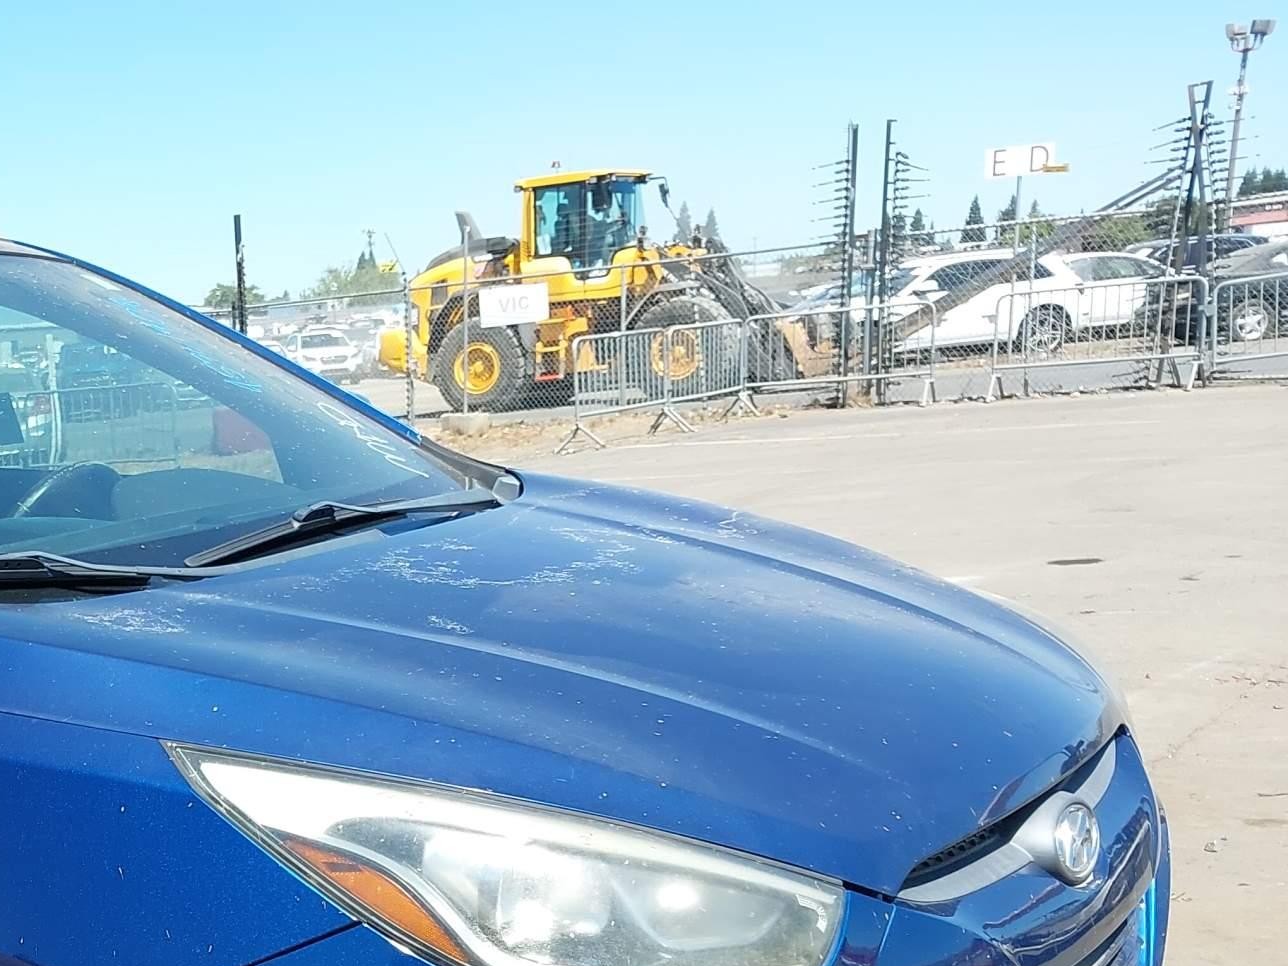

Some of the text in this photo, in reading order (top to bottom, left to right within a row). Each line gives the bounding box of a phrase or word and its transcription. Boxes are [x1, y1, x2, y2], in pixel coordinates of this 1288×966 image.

[992, 145, 1049, 177] E D
[498, 296, 529, 313] VIC
